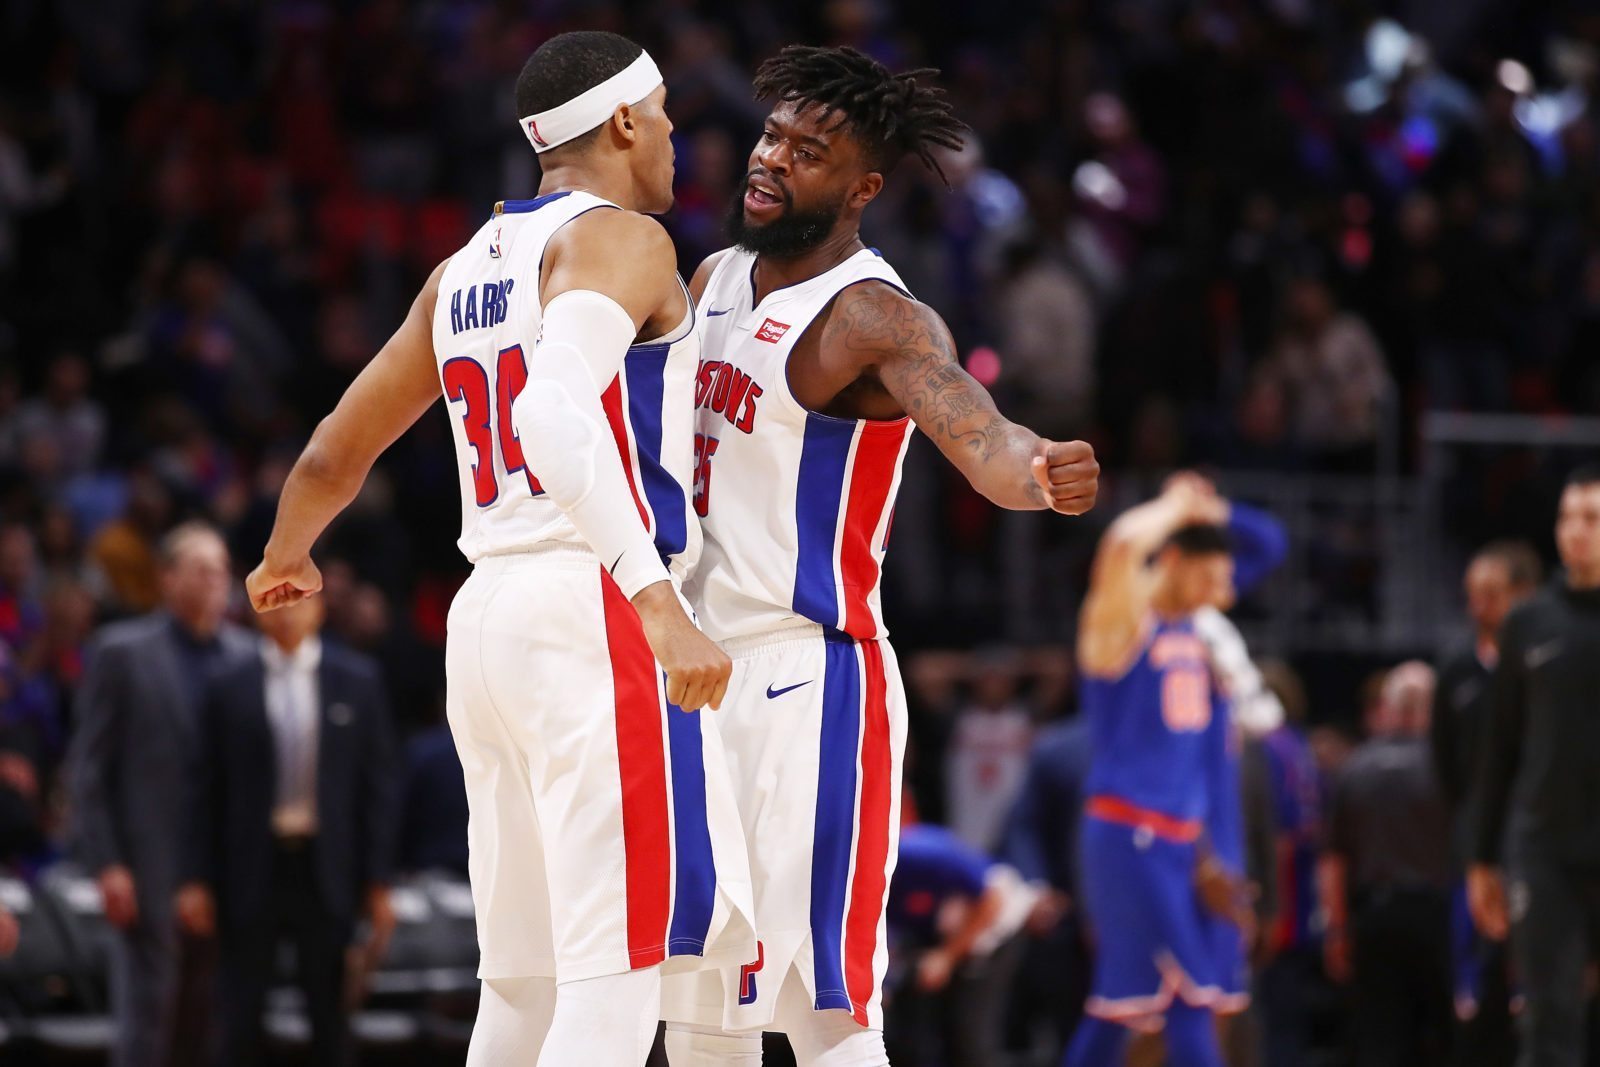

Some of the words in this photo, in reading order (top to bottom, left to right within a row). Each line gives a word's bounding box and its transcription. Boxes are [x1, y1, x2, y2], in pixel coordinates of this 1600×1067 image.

[451, 278, 514, 336] HARS
[443, 343, 546, 508] 34
[695, 359, 763, 434] STONS
